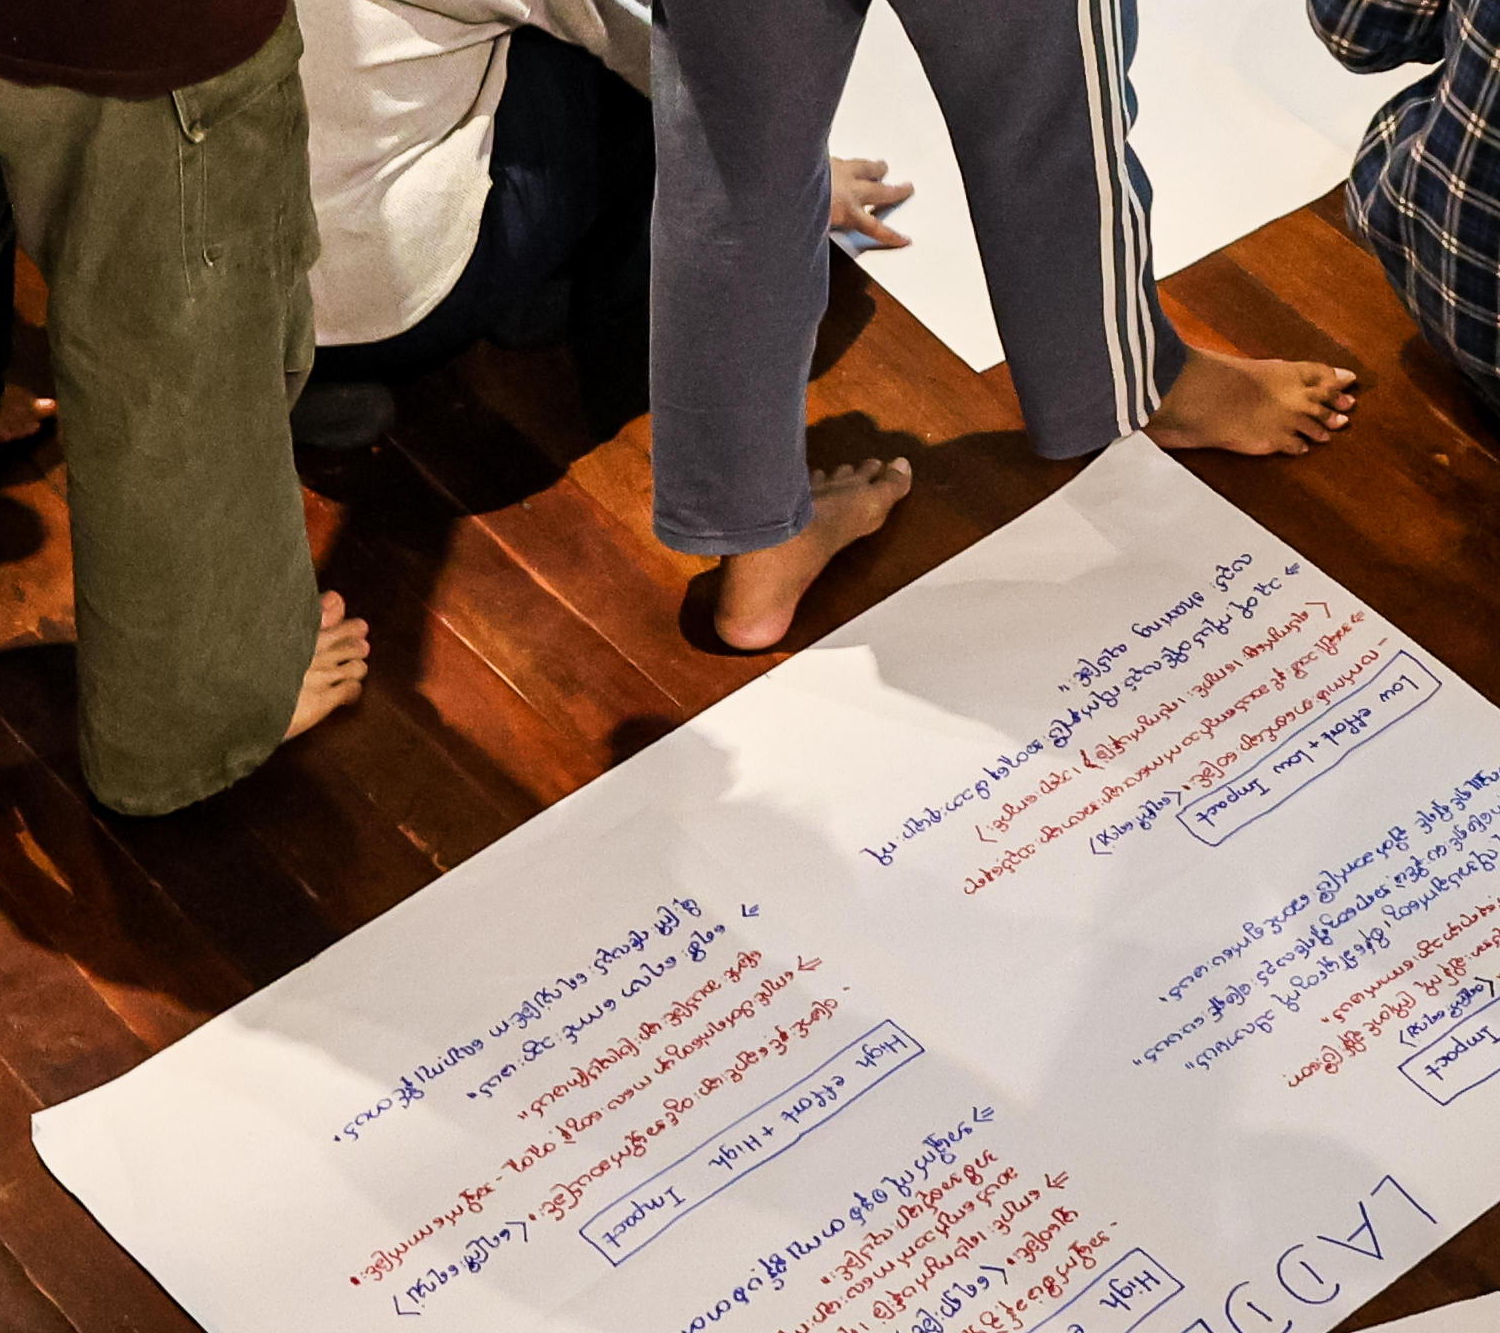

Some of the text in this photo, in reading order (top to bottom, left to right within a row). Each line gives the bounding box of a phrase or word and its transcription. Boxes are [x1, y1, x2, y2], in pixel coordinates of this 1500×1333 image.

[1319, 707, 1373, 747] effort
[1194, 766, 1272, 828] Impact
[854, 1022, 909, 1069] High
[779, 1074, 847, 1125] effort
[707, 1133, 764, 1171] High
[601, 1185, 687, 1249] Impact
[1098, 1269, 1162, 1312] High
